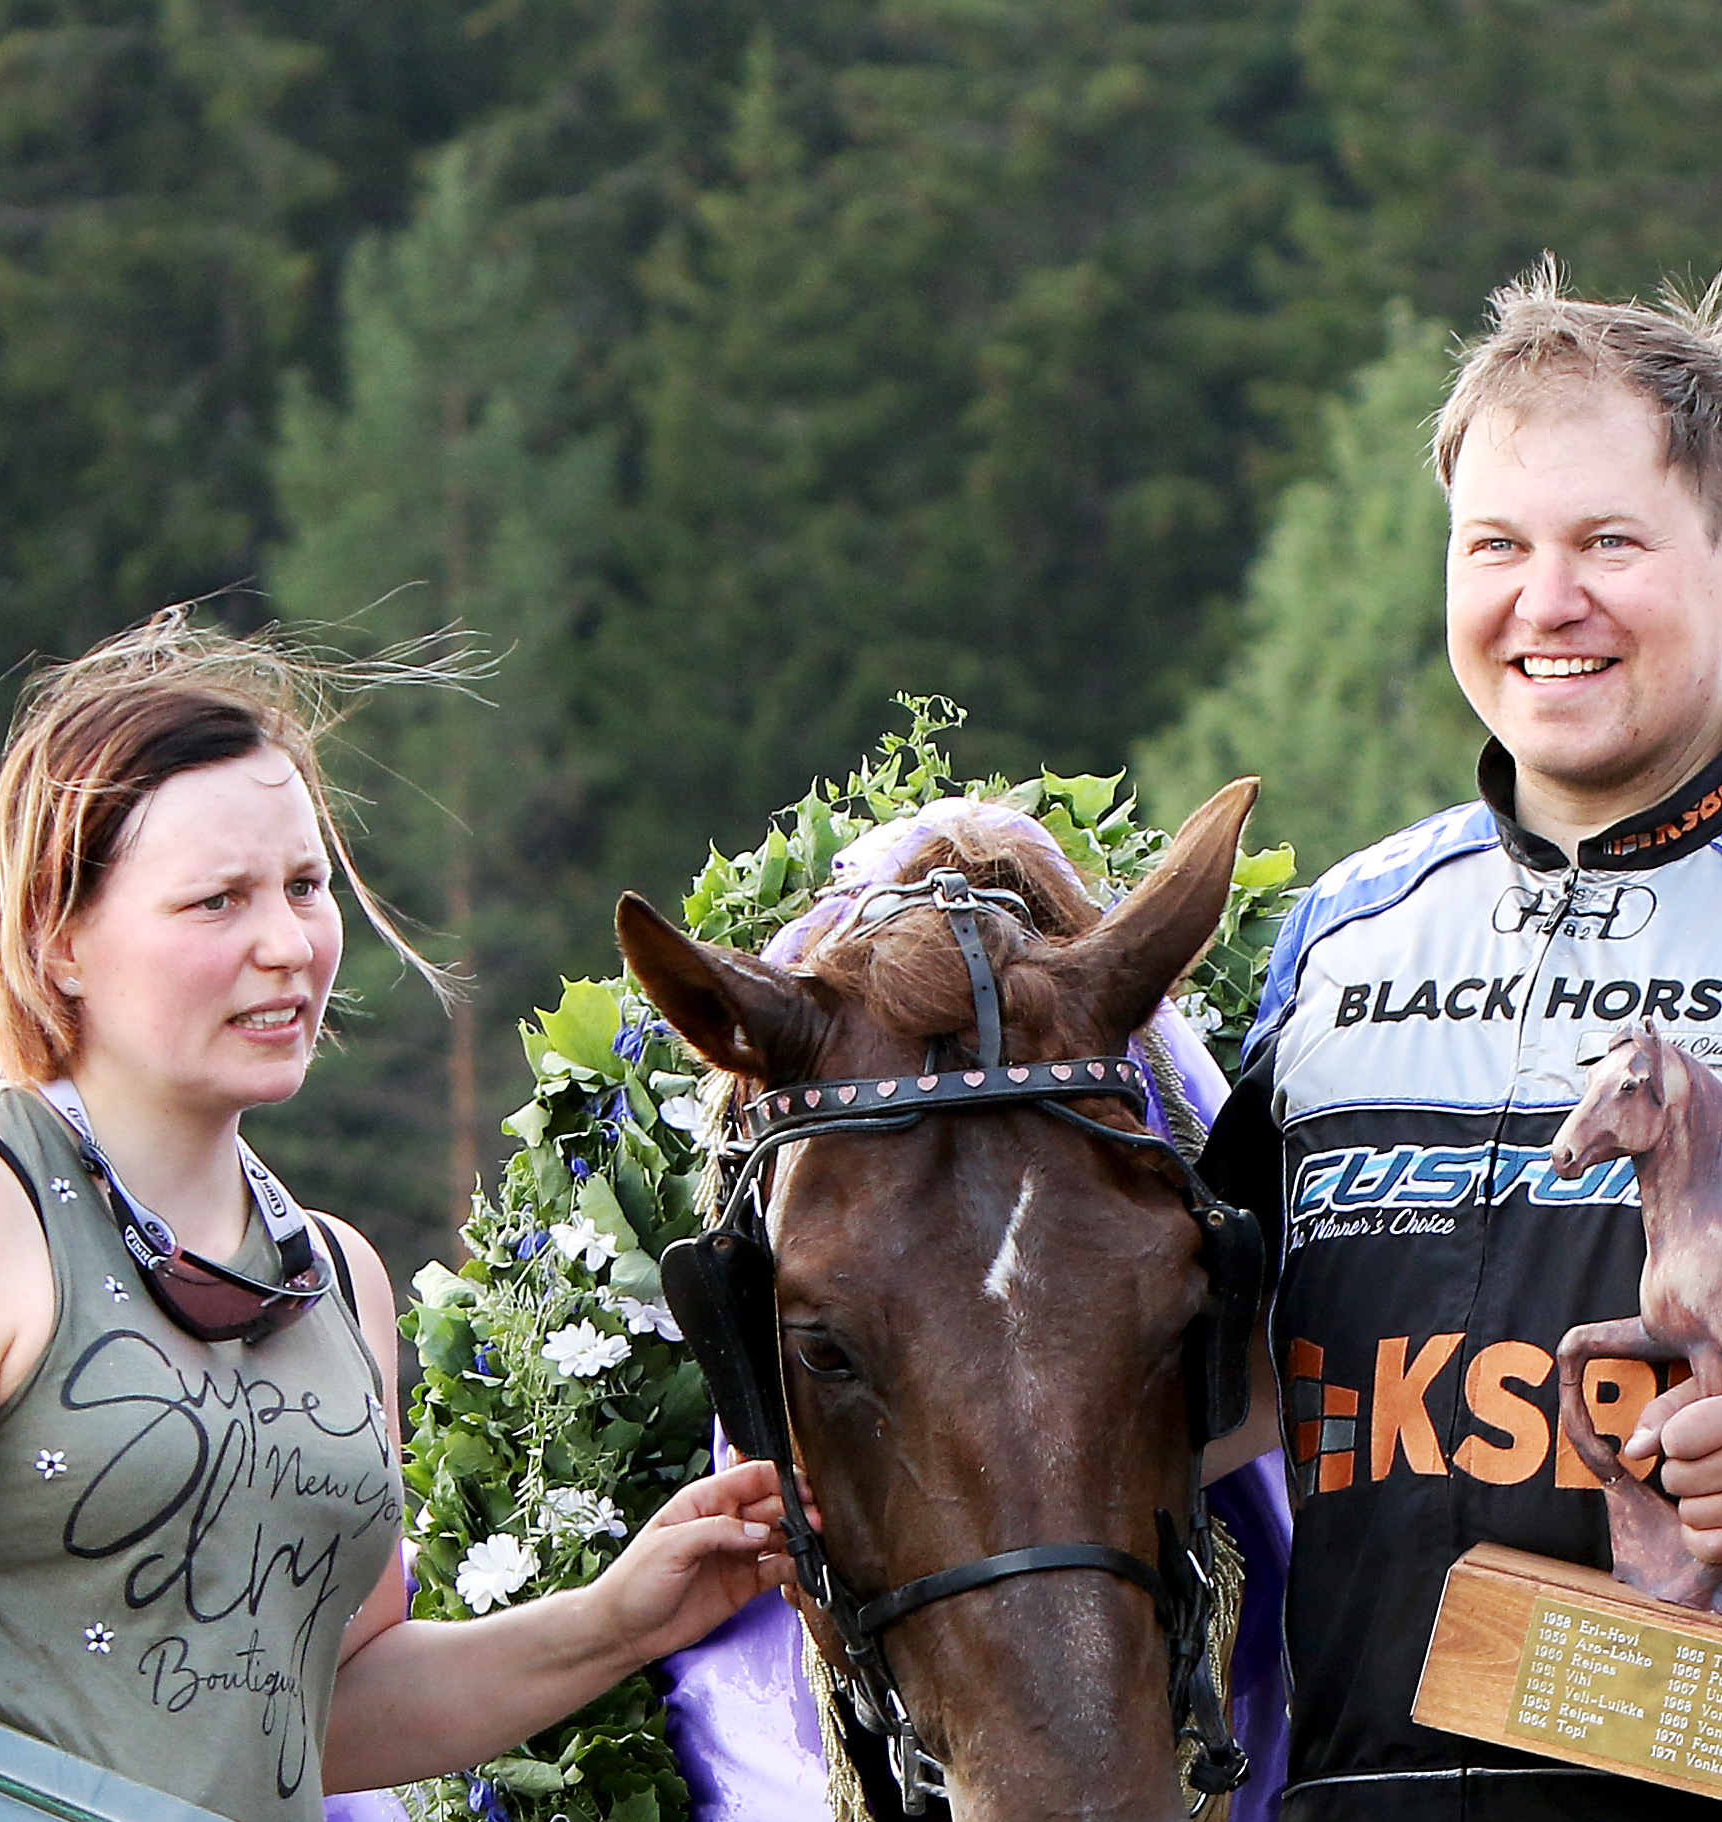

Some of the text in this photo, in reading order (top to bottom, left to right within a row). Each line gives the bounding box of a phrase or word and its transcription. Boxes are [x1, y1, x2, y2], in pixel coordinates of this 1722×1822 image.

[1334, 972, 1524, 1028] BLACK
[1310, 1209, 1384, 1243] Winner's
[1389, 1207, 1457, 1238] Choice
[1371, 1332, 1692, 1490] KSB
[266, 1444, 348, 1500] New
[1543, 1612, 1572, 1628] 1958
[1539, 1628, 1652, 1667] 1959 Aro-Lohko
[1676, 1646, 1705, 1663] 1965
[1535, 1645, 1617, 1675] 1960 Reipas
[1531, 1661, 1592, 1686] 1961 Vihi
[1672, 1662, 1701, 1680] 1966
[1526, 1678, 1555, 1694] 1962
[1668, 1679, 1698, 1696] 1967
[1522, 1694, 1604, 1725] 1963 Reipas
[1664, 1695, 1692, 1713] 1968
[1518, 1710, 1587, 1739] 1964 Topi
[1659, 1712, 1689, 1729] 1969
[1655, 1728, 1684, 1746] 1970
[1651, 1745, 1677, 1762] 1971
